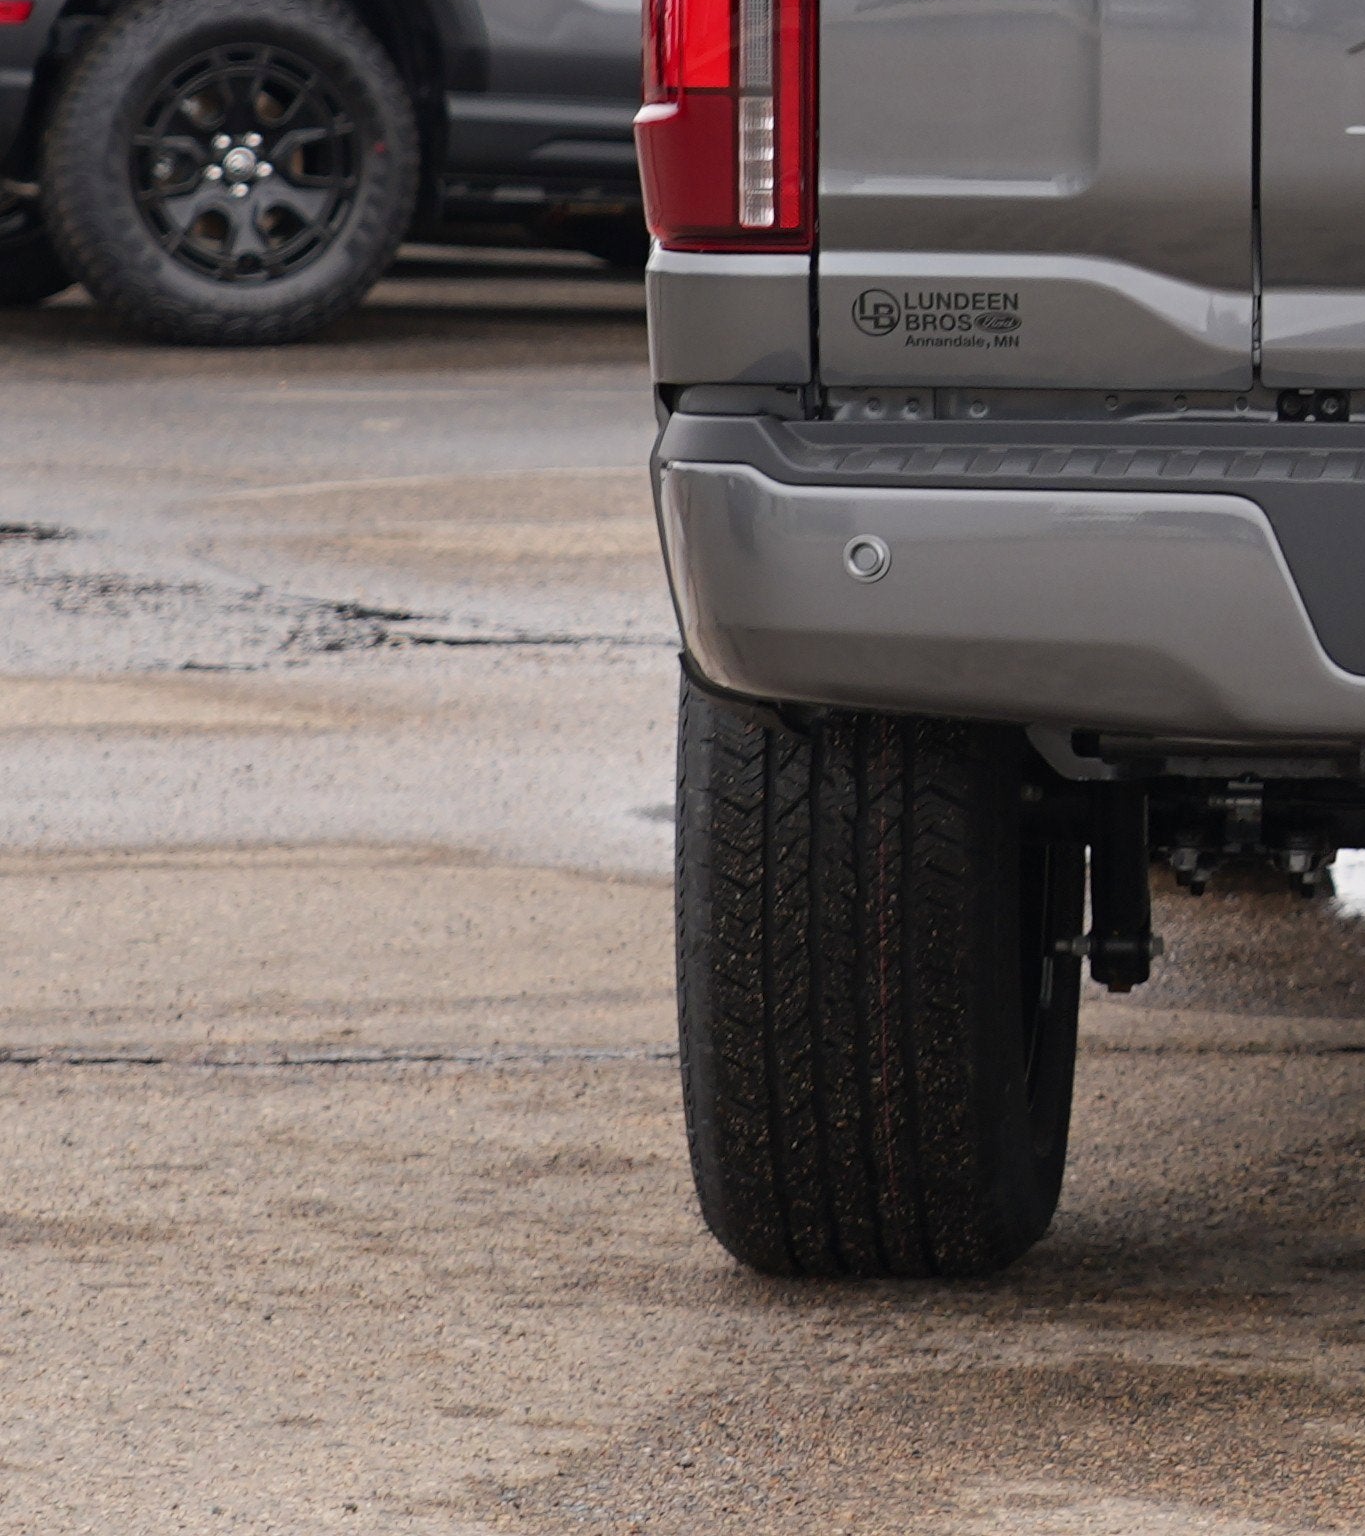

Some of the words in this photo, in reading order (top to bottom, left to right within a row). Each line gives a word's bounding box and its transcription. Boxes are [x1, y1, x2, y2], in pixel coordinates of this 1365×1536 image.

[904, 292, 1019, 311] LUNDEEN
[905, 313, 973, 332] BROS
[994, 335, 1020, 348] MN
